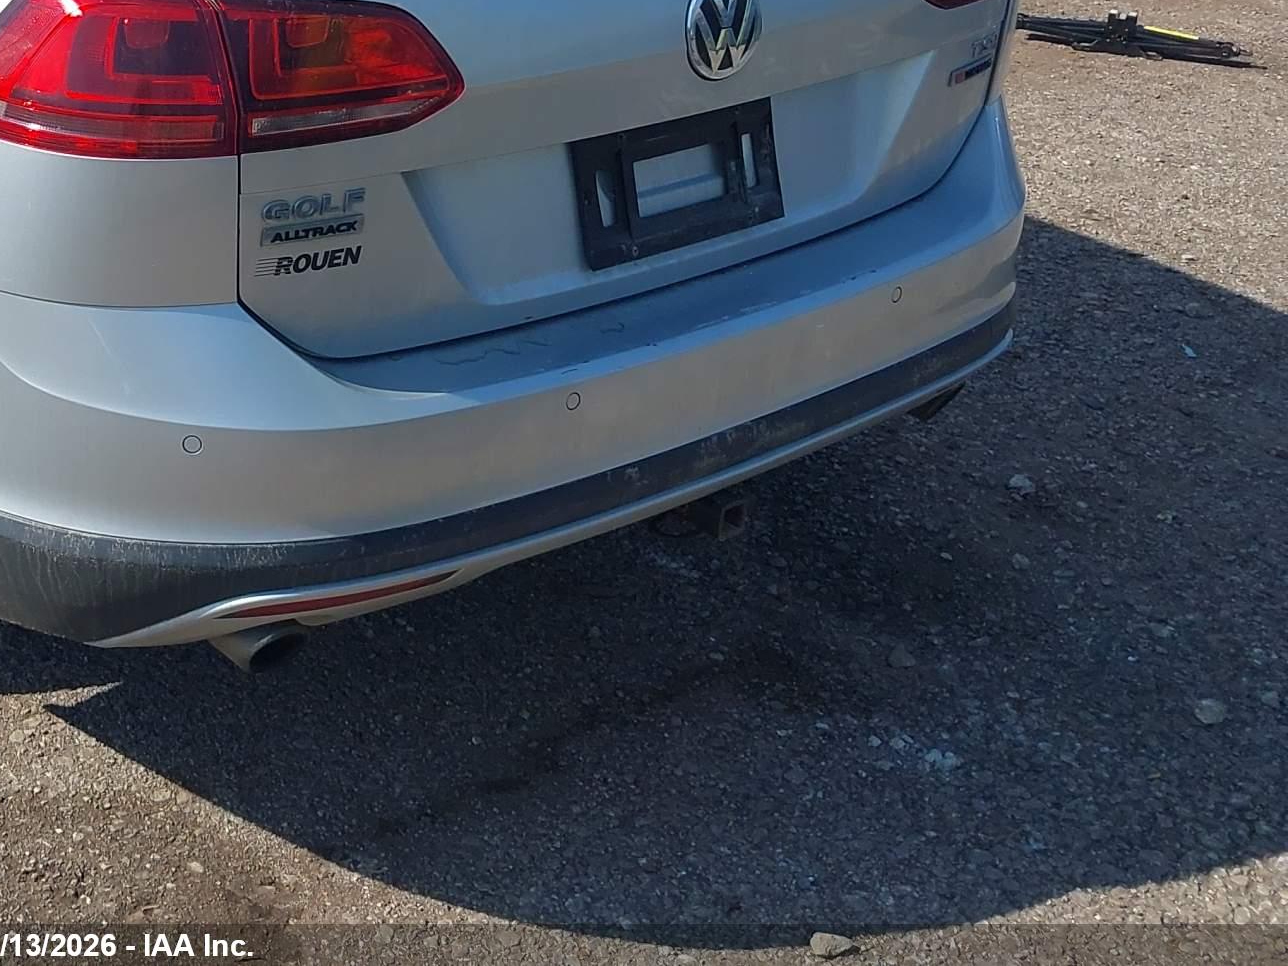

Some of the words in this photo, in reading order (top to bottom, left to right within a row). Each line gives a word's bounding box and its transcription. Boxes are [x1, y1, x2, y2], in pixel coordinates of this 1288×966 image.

[262, 187, 366, 222] GOLF
[270, 220, 358, 244] ALLTRACK
[272, 245, 363, 276] ROUEN
